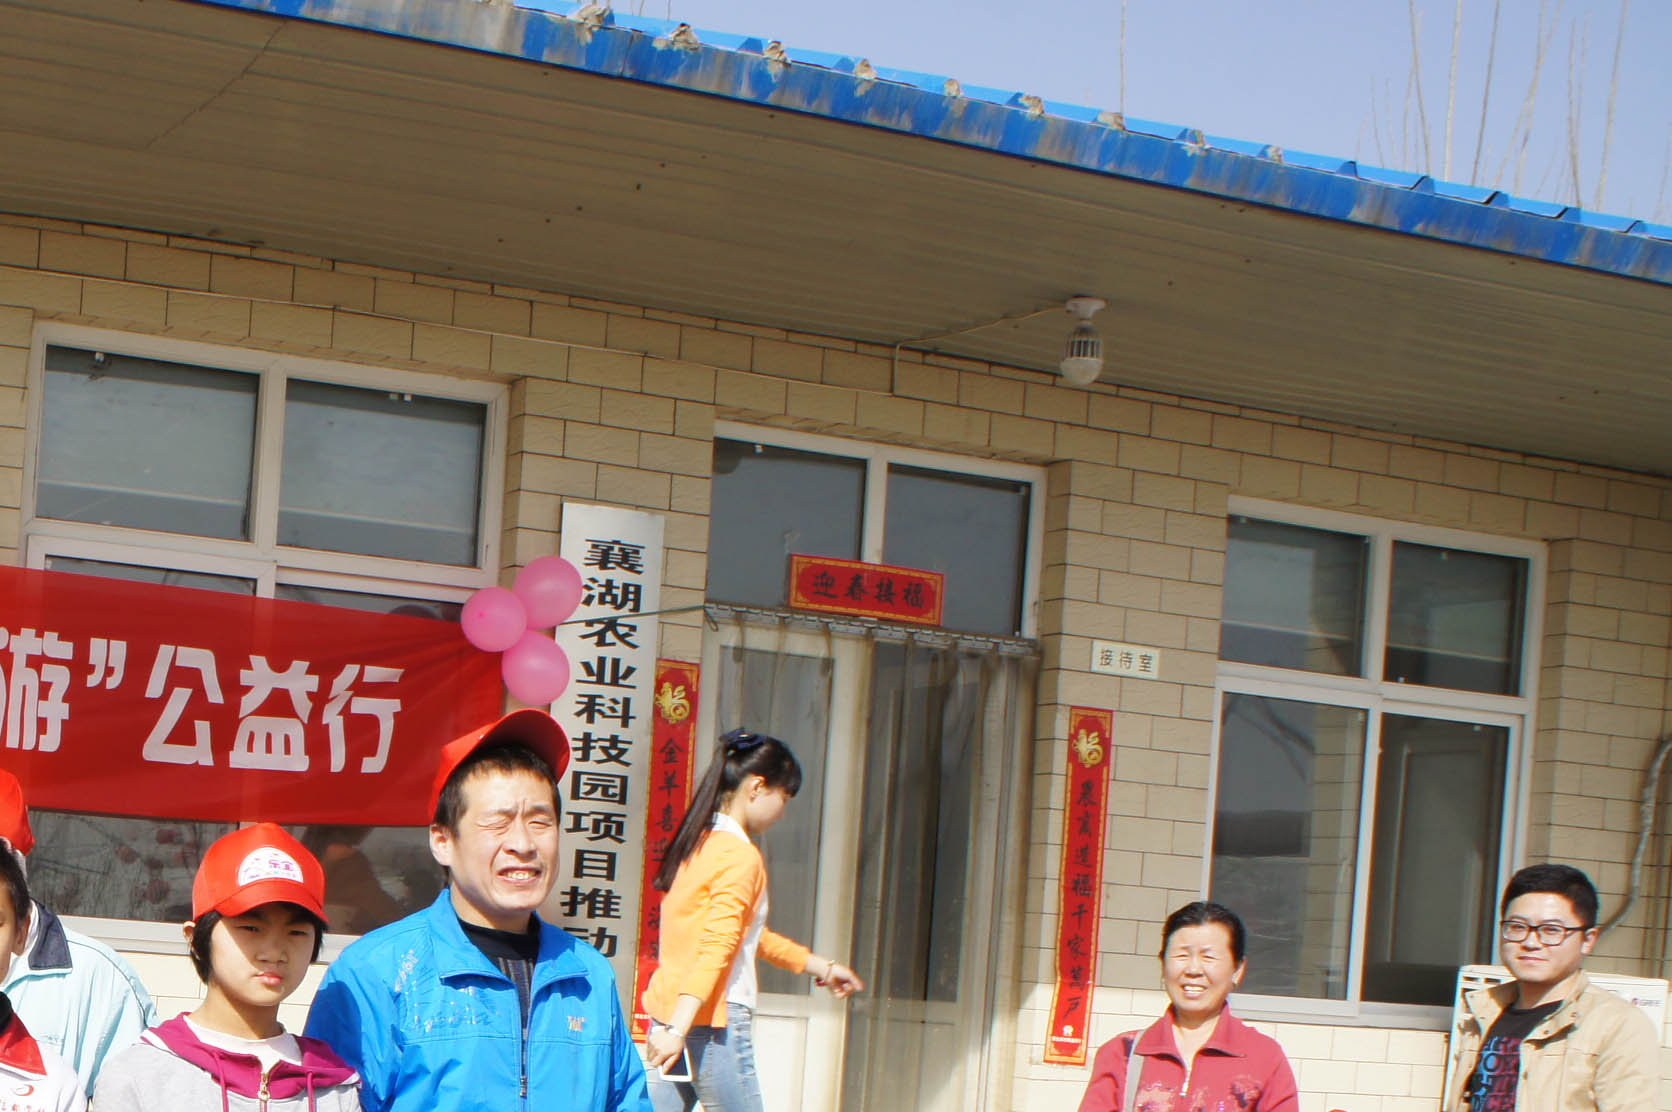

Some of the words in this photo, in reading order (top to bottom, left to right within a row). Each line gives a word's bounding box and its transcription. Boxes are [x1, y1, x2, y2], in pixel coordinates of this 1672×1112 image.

[811, 570, 925, 609] 迎春接福
[1099, 648, 1153, 673] 接待室
